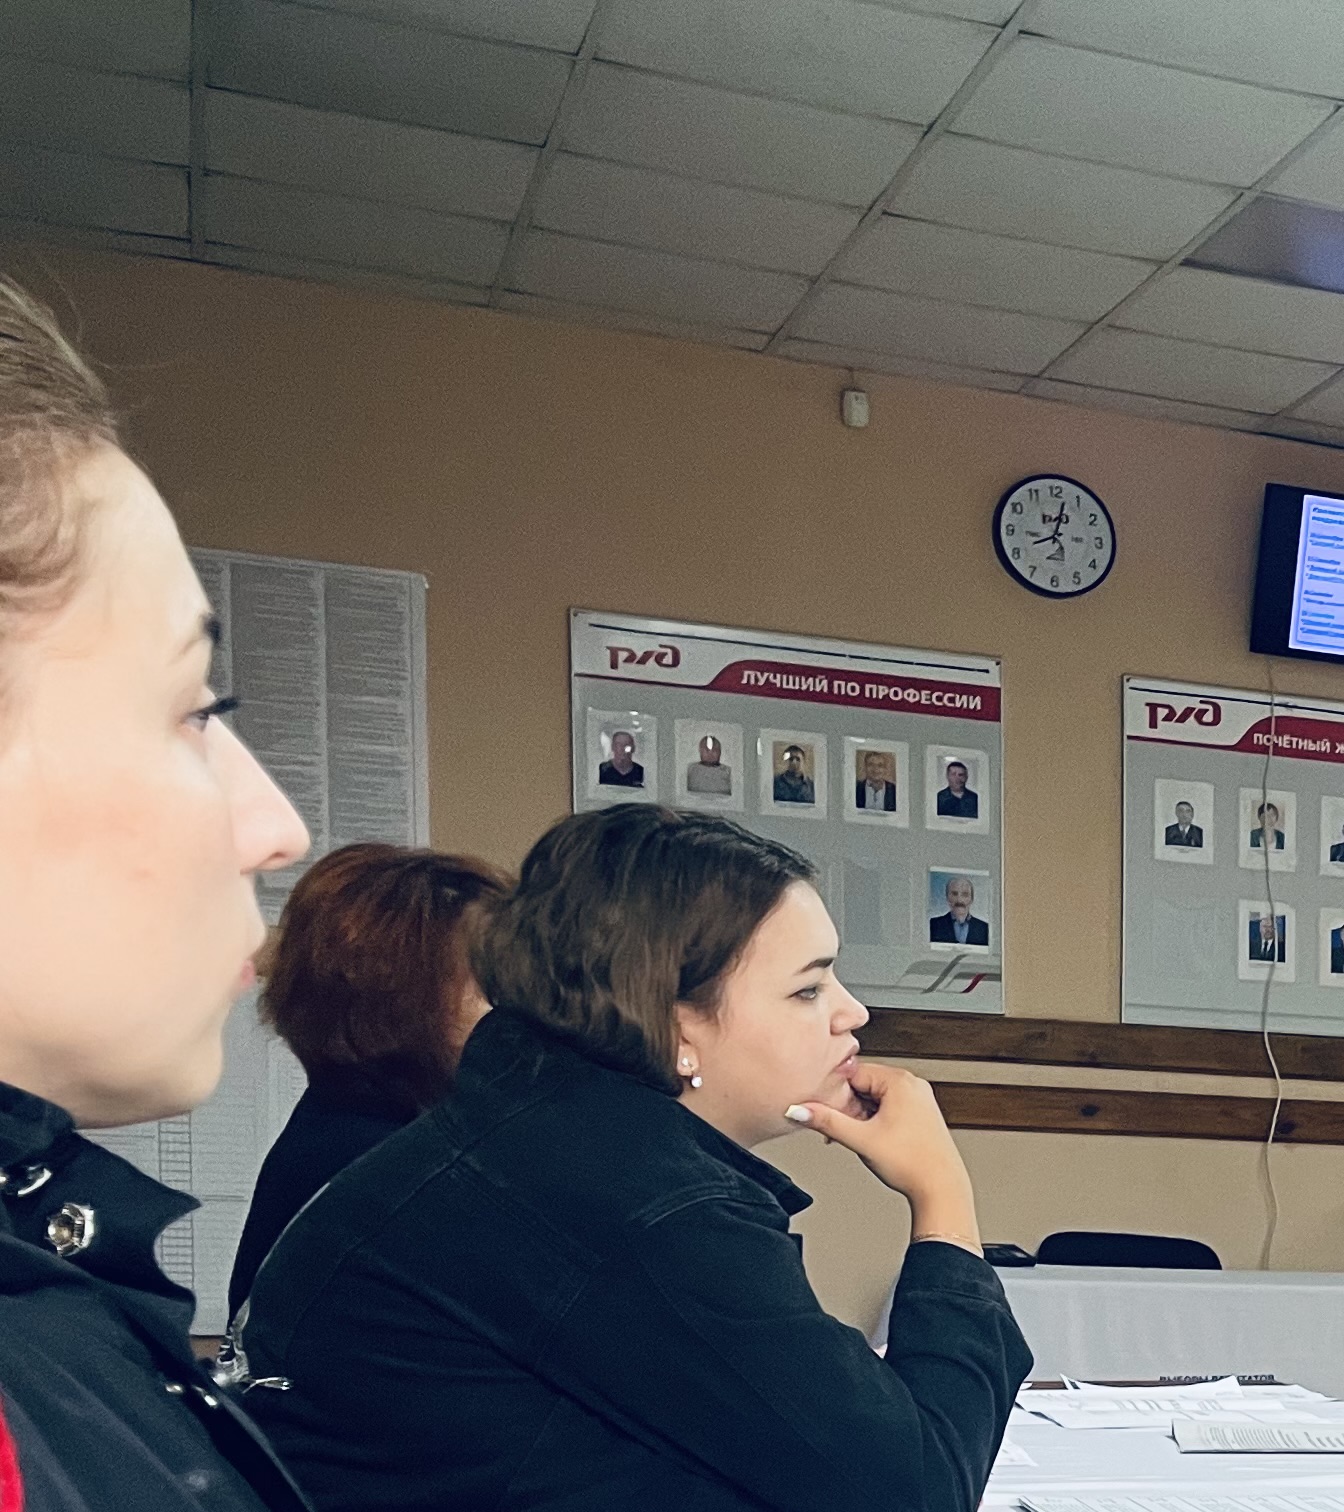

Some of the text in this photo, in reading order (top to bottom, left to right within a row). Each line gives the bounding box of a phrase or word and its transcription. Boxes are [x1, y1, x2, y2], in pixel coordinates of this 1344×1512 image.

[1028, 488, 1039, 501] 11
[1048, 486, 1063, 499] 12
[1076, 495, 1080, 508] 1
[1010, 502, 1024, 515] 10
[1088, 513, 1098, 526] 2
[1005, 523, 1015, 536] 9
[1094, 536, 1103, 549] 3
[1012, 547, 1020, 560] 8
[1088, 558, 1097, 570] 4
[1028, 565, 1037, 578] 7
[1072, 571, 1081, 585] 5
[1050, 575, 1059, 587] 6
[740, 669, 982, 711] ЛУЧШИЙ ПО ПРОФЕССИИ
[1253, 732, 1331, 754] ПОЧЁТНЫЙ
